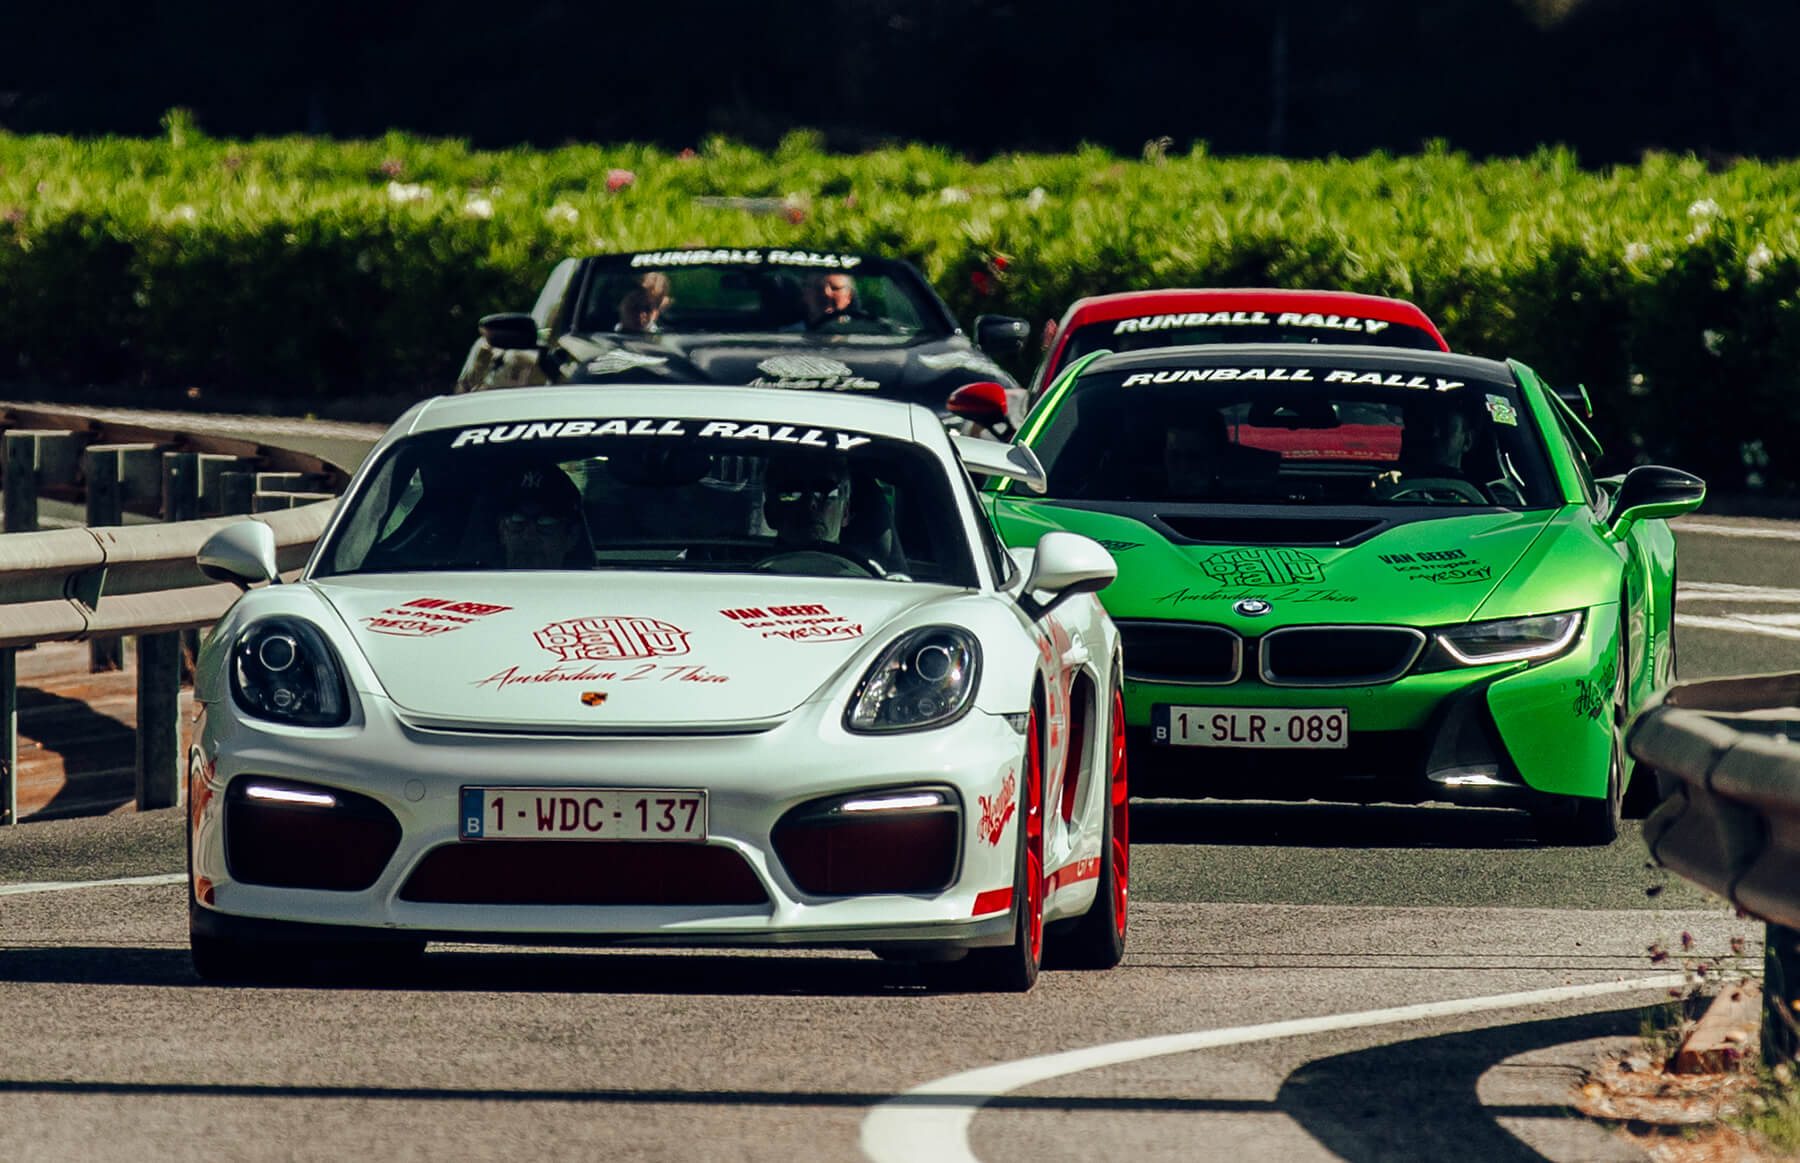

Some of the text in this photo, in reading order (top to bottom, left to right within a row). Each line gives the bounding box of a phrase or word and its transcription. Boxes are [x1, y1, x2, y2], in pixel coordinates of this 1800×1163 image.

[630, 250, 861, 269] RUNBALL RALLY
[1113, 311, 1389, 335] RUNBALL RALLY
[1121, 368, 1465, 393] RUNBALL RALLY
[450, 419, 872, 451] RUNBALL RALLY
[719, 603, 831, 620] VAN GEERT
[469, 664, 617, 691] Amsterdam
[620, 663, 657, 682] 2
[1156, 713, 1342, 743] B 1-SLR-089
[466, 796, 699, 833] B 1-WDC-137
